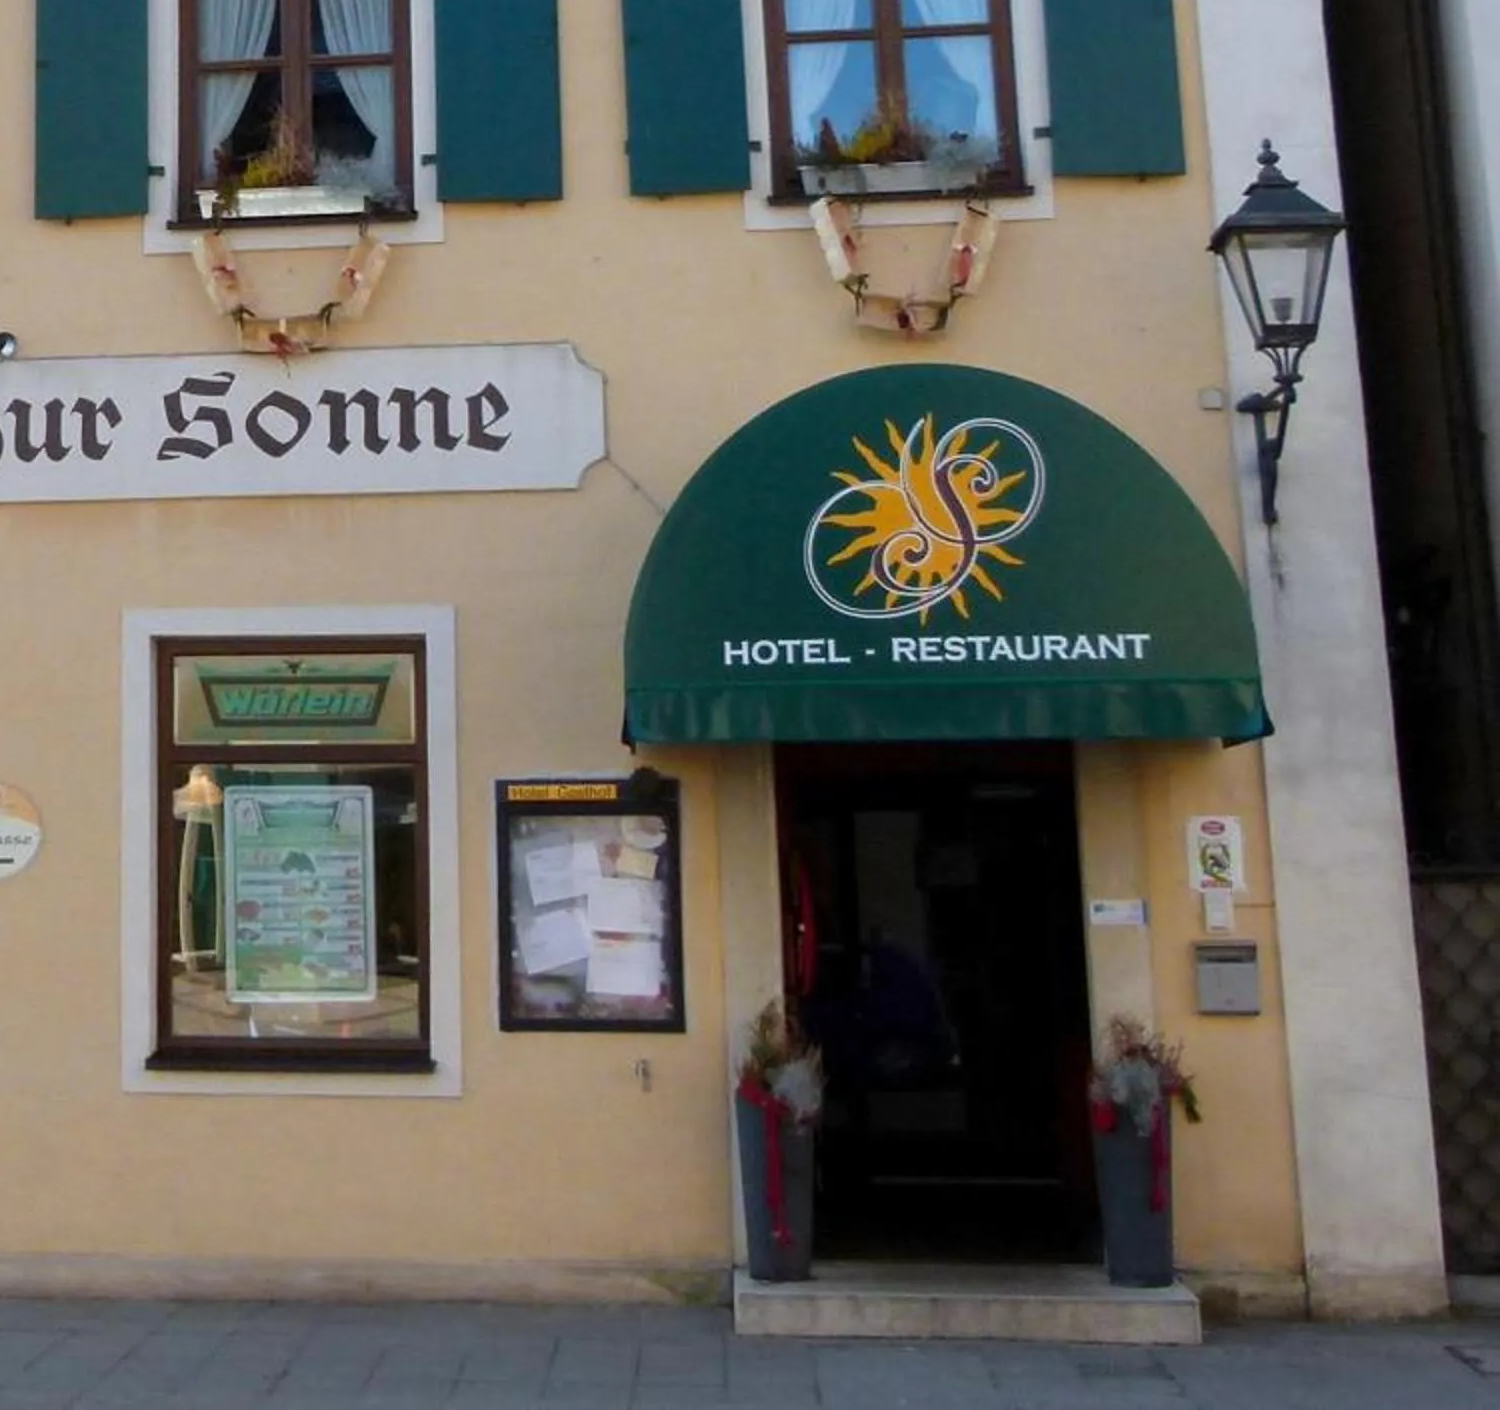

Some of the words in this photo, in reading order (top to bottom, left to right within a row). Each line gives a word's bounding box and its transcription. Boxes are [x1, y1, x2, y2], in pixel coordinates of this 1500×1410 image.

[156, 371, 512, 461] Sonne
[723, 639, 851, 665] HOTEL
[891, 634, 1150, 662] RESTAURANT
